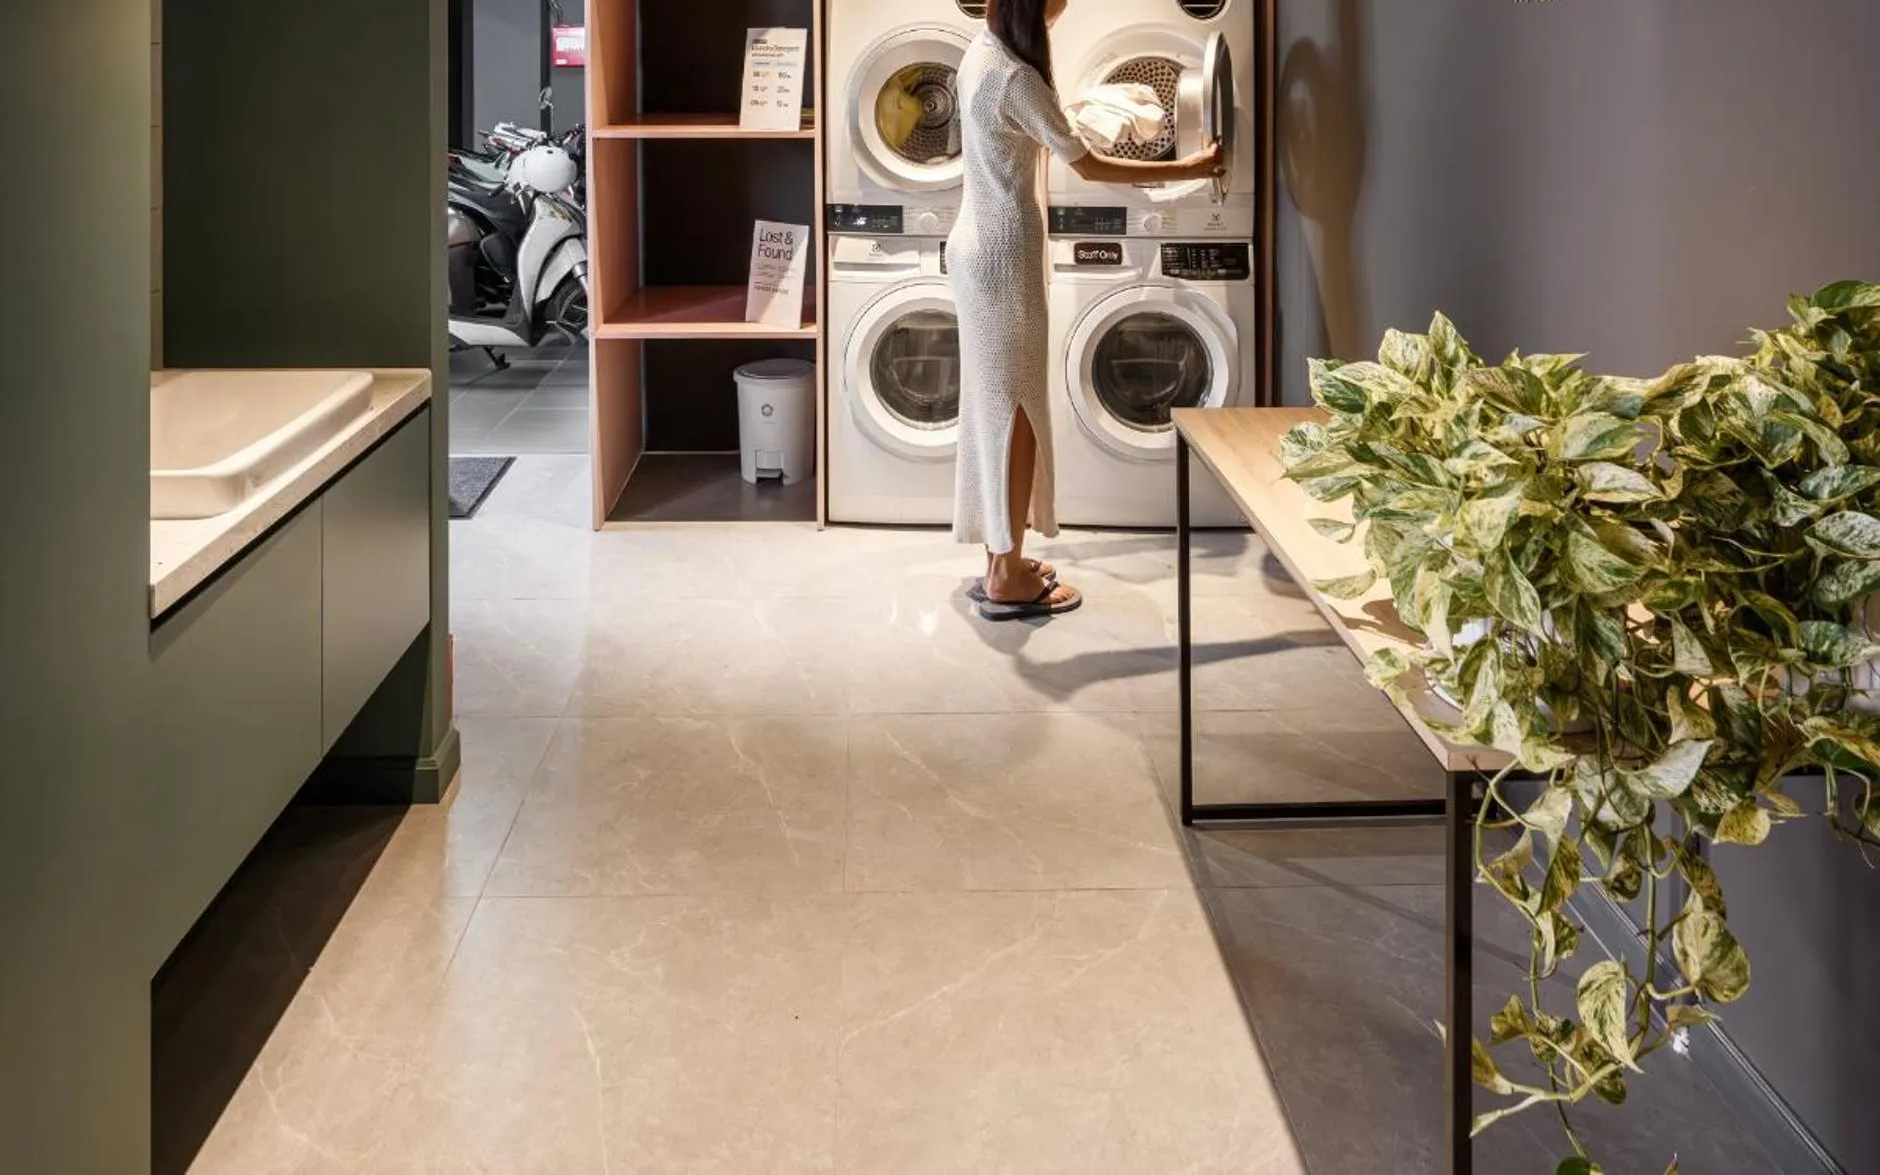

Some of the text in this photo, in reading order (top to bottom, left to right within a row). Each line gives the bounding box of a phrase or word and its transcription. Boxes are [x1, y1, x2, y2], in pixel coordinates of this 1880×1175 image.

[759, 228, 793, 245] Lost &
[757, 244, 793, 261] Found
